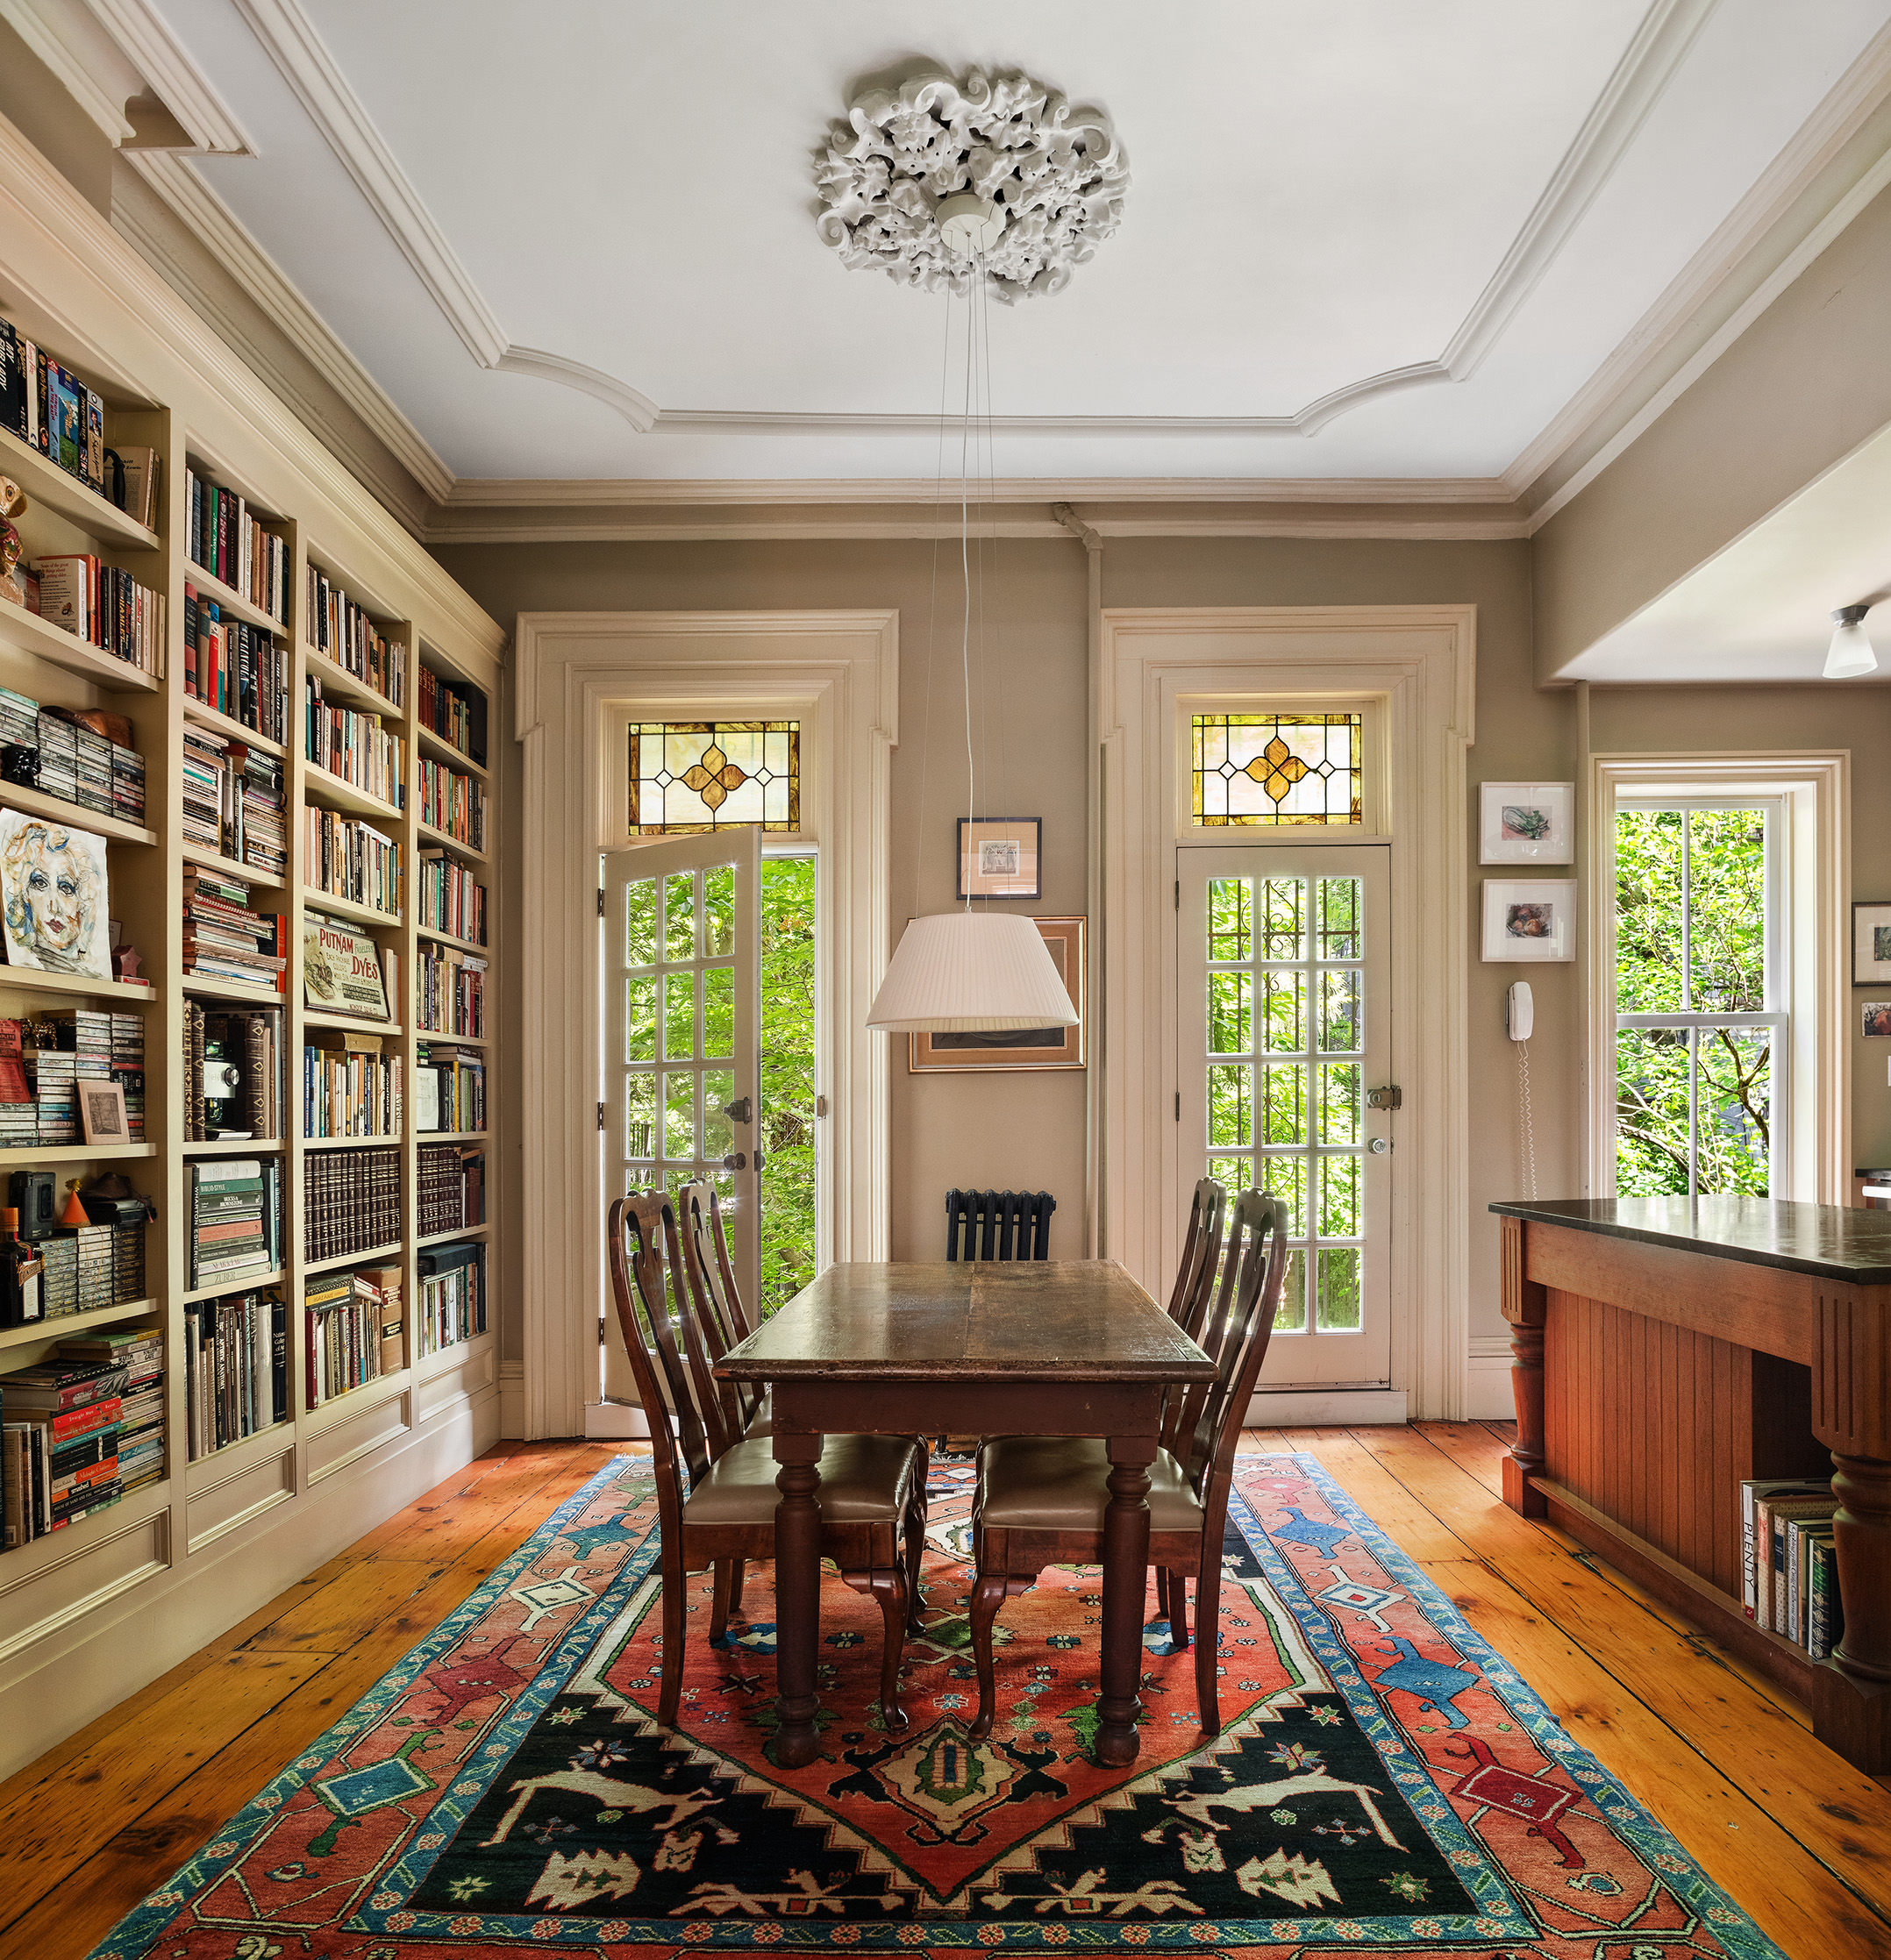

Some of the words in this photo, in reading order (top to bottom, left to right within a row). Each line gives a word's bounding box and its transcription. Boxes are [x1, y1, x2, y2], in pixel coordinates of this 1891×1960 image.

[319, 928, 353, 954] PUTNAM
[350, 955, 378, 980] DYES
[69, 1413, 84, 1421] Straight
[70, 1481, 89, 1494] smashed
[1744, 1522, 1754, 1588] PLENTY
